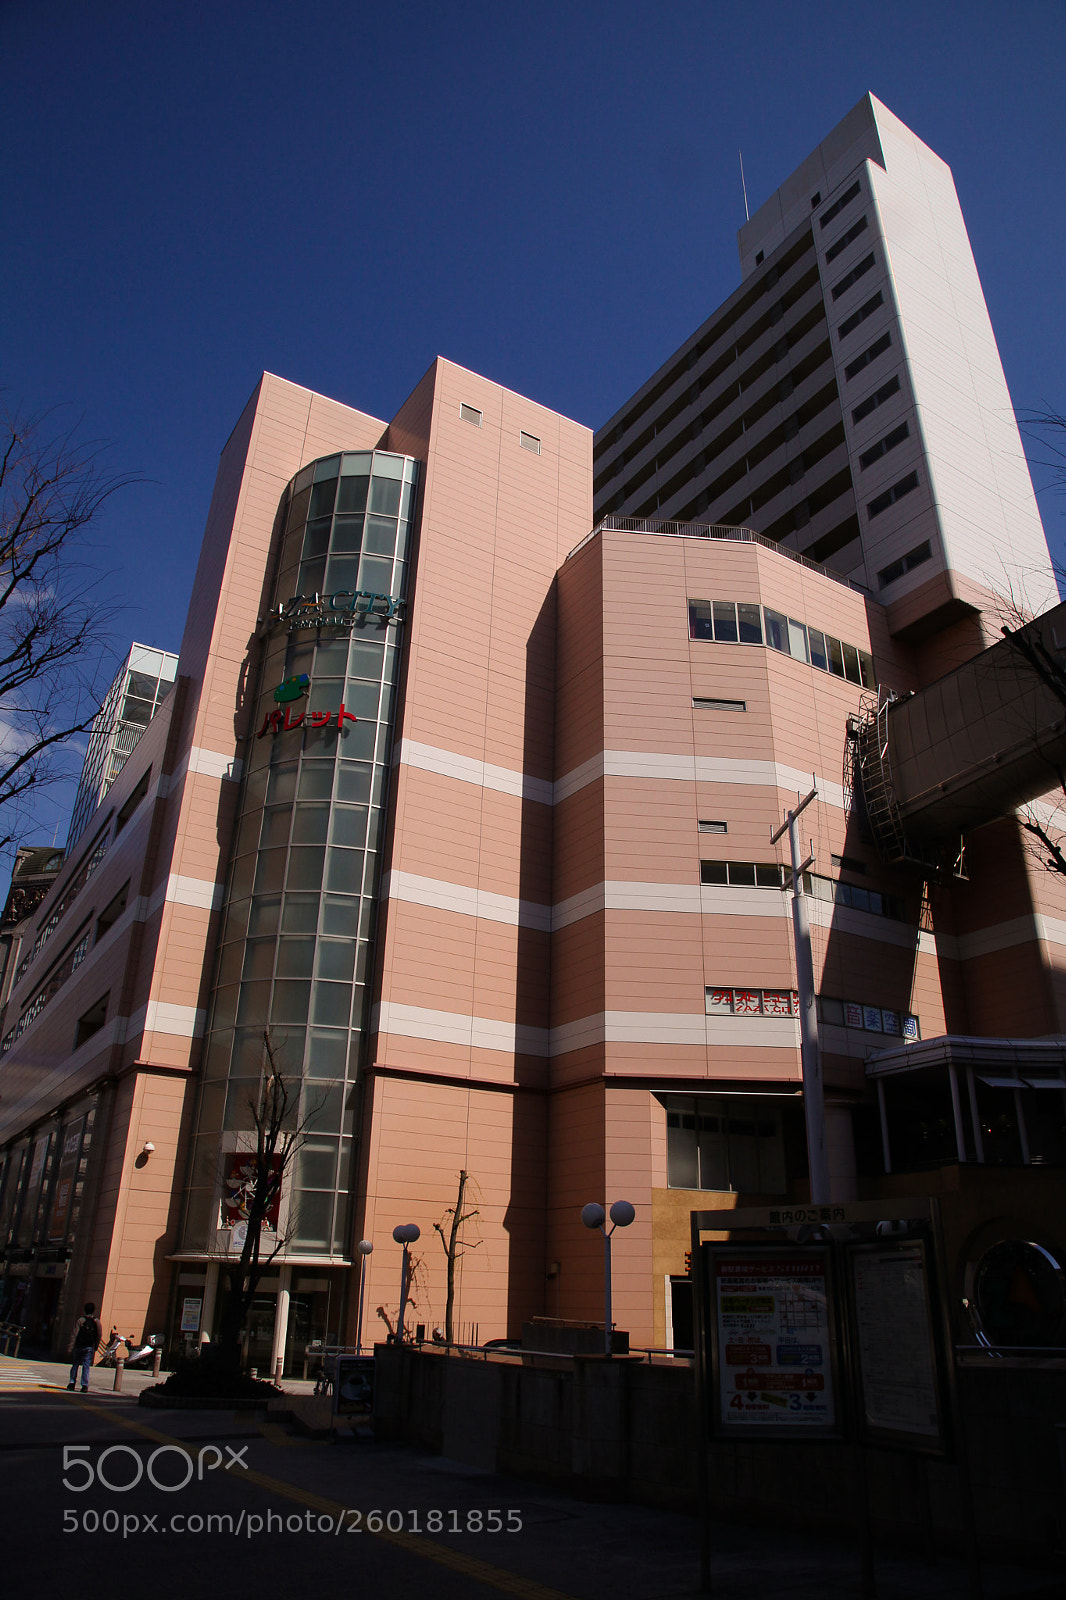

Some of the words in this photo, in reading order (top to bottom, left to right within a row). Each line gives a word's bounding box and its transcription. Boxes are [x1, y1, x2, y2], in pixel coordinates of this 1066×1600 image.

[329, 590, 406, 618] CITY
[257, 703, 358, 739] パレット
[846, 1004, 917, 1038] 音楽空間
[769, 1208, 846, 1224] 館内のご案内
